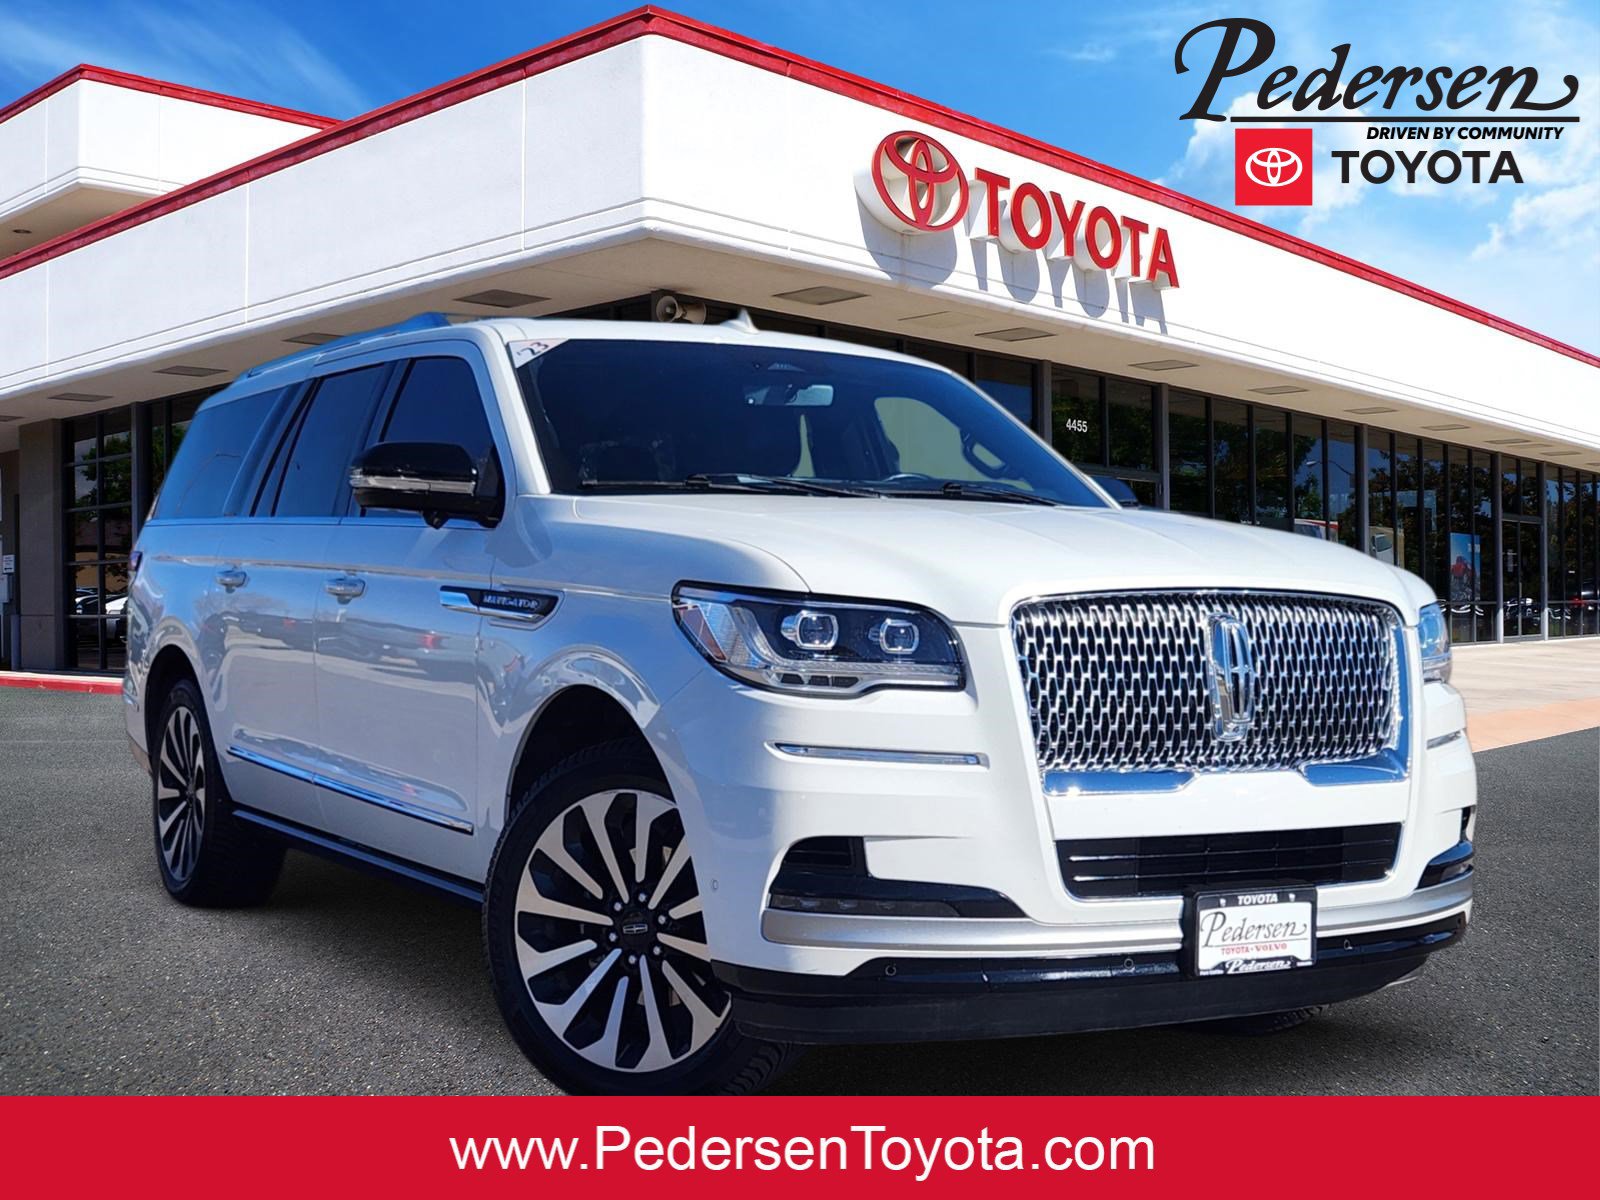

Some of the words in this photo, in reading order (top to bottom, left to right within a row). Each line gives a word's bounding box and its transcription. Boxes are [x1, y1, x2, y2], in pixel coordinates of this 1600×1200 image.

[974, 167, 1180, 289] TOYOTA
[1065, 418, 1088, 433] 4455
[1237, 893, 1278, 905] TOYOTA
[1200, 911, 1308, 948] Pedersen
[1221, 947, 1250, 955] TOYOTA
[1255, 943, 1288, 952] VOLVO
[1225, 959, 1291, 974] Pedersen
